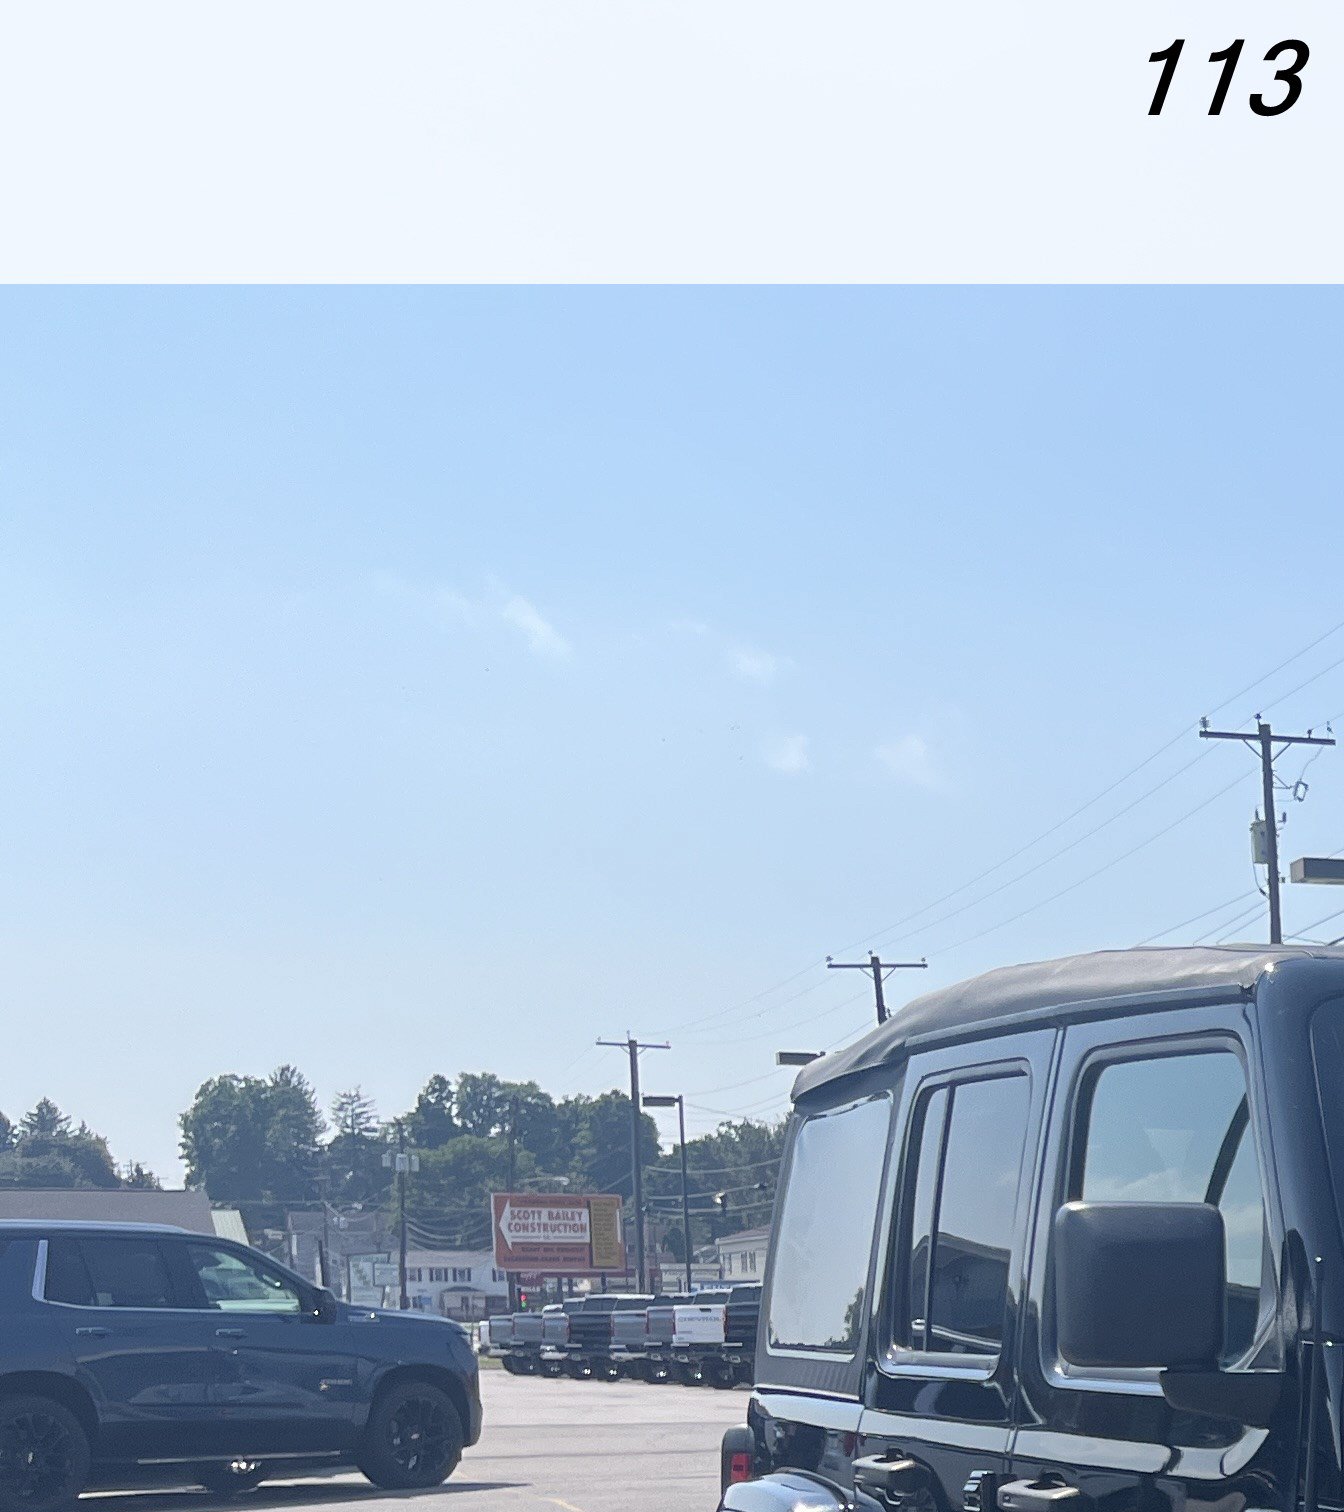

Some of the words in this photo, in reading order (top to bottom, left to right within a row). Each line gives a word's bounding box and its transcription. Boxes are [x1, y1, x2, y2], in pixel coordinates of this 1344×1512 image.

[510, 1210, 543, 1221] SCOTT
[547, 1210, 584, 1221] BAILEY
[507, 1222, 587, 1234] CONSTRUCTION
